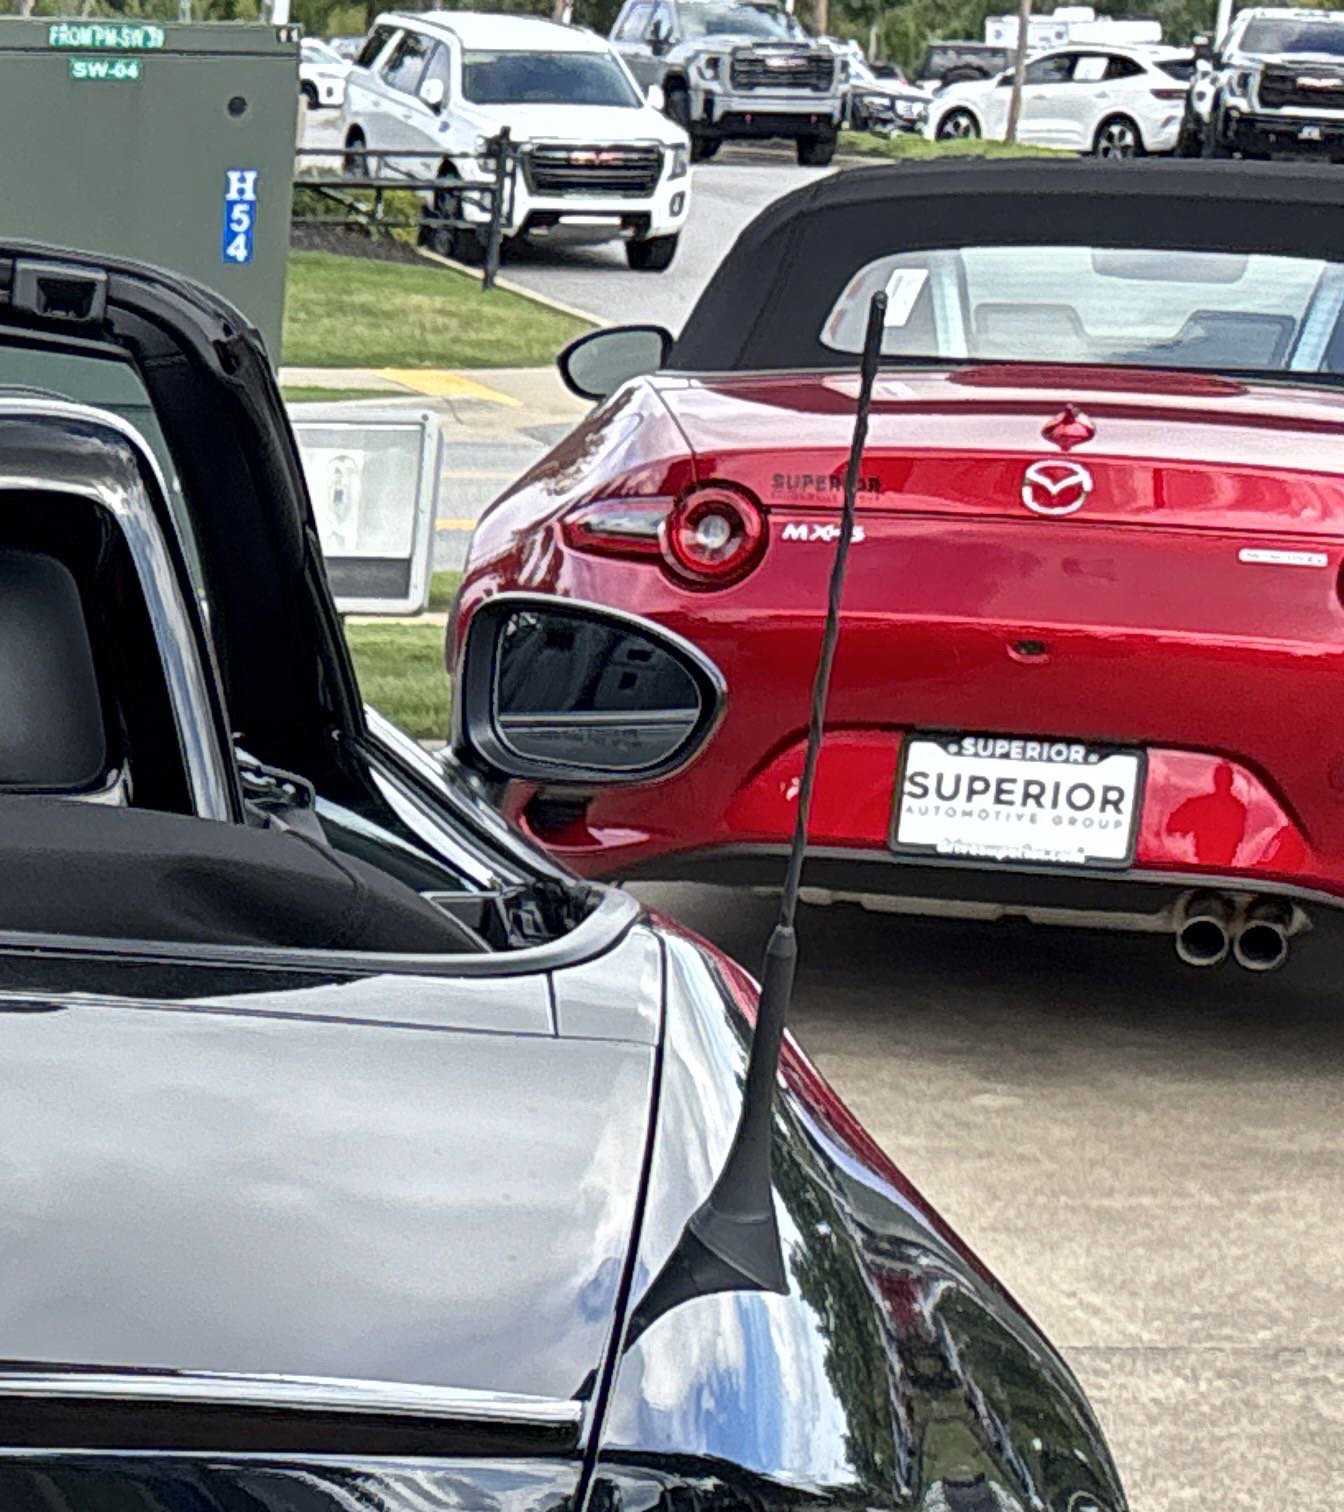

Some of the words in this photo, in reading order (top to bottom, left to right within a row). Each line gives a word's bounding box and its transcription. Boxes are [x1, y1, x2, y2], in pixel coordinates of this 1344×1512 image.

[72, 61, 139, 78] SW-04
[961, 738, 1086, 763] SUPERIOR
[904, 771, 1126, 815] SUPERIOR
[905, 805, 1038, 825] AUTOMOTIVE
[1052, 815, 1124, 830] GROUP
